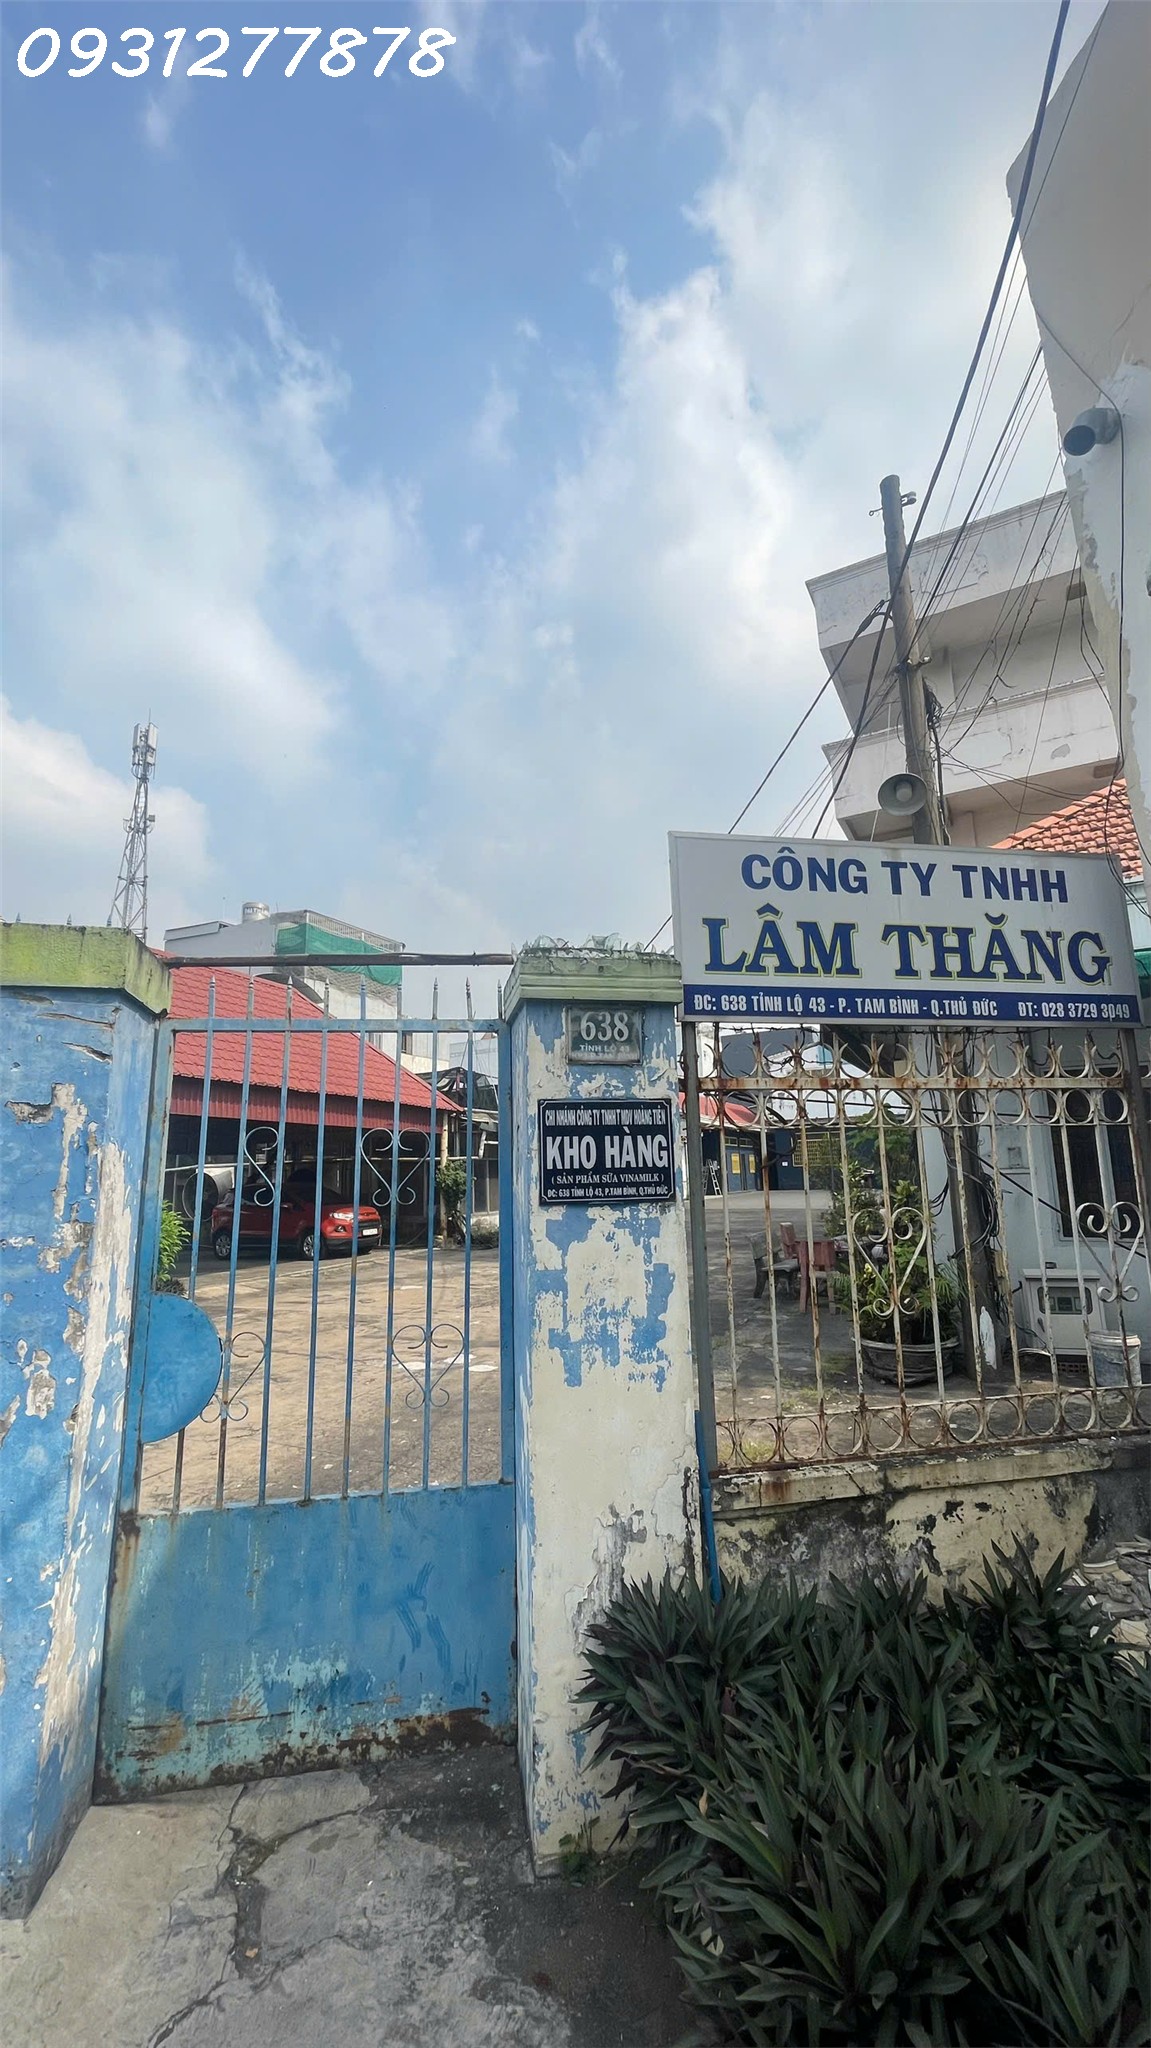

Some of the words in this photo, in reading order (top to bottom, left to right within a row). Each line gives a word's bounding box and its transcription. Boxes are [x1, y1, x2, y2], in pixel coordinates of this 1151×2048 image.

[741, 846, 868, 895] CÔNG
[880, 860, 937, 897] TY
[952, 864, 1069, 903] TNHH
[702, 902, 862, 978] LÂM
[880, 912, 1113, 986] THĂNG
[694, 994, 717, 1011] ĐC:
[721, 995, 747, 1012] 638
[751, 992, 782, 1012] TỈNH
[787, 994, 803, 1016] LỘ
[809, 997, 826, 1013] 43
[838, 997, 851, 1014] P.
[855, 998, 886, 1014] TAM
[890, 995, 919, 1014] BÌNH
[973, 998, 998, 1017] ĐỨC
[1018, 1001, 1039, 1018] ĐT:
[1042, 1002, 1065, 1018] 028
[1069, 1003, 1098, 1019] 3729
[1101, 1003, 1130, 1020] 3049
[580, 1011, 629, 1042] 638
[545, 1109, 555, 1126] CHI
[556, 1105, 576, 1126] NHÁNH
[577, 1105, 592, 1126] CÔNG
[593, 1109, 600, 1125] TY
[546, 1135, 597, 1170] KHO
[604, 1126, 669, 1168] HÀNG
[601, 1172, 618, 1183] SỮA
[558, 1189, 570, 1197] 638
